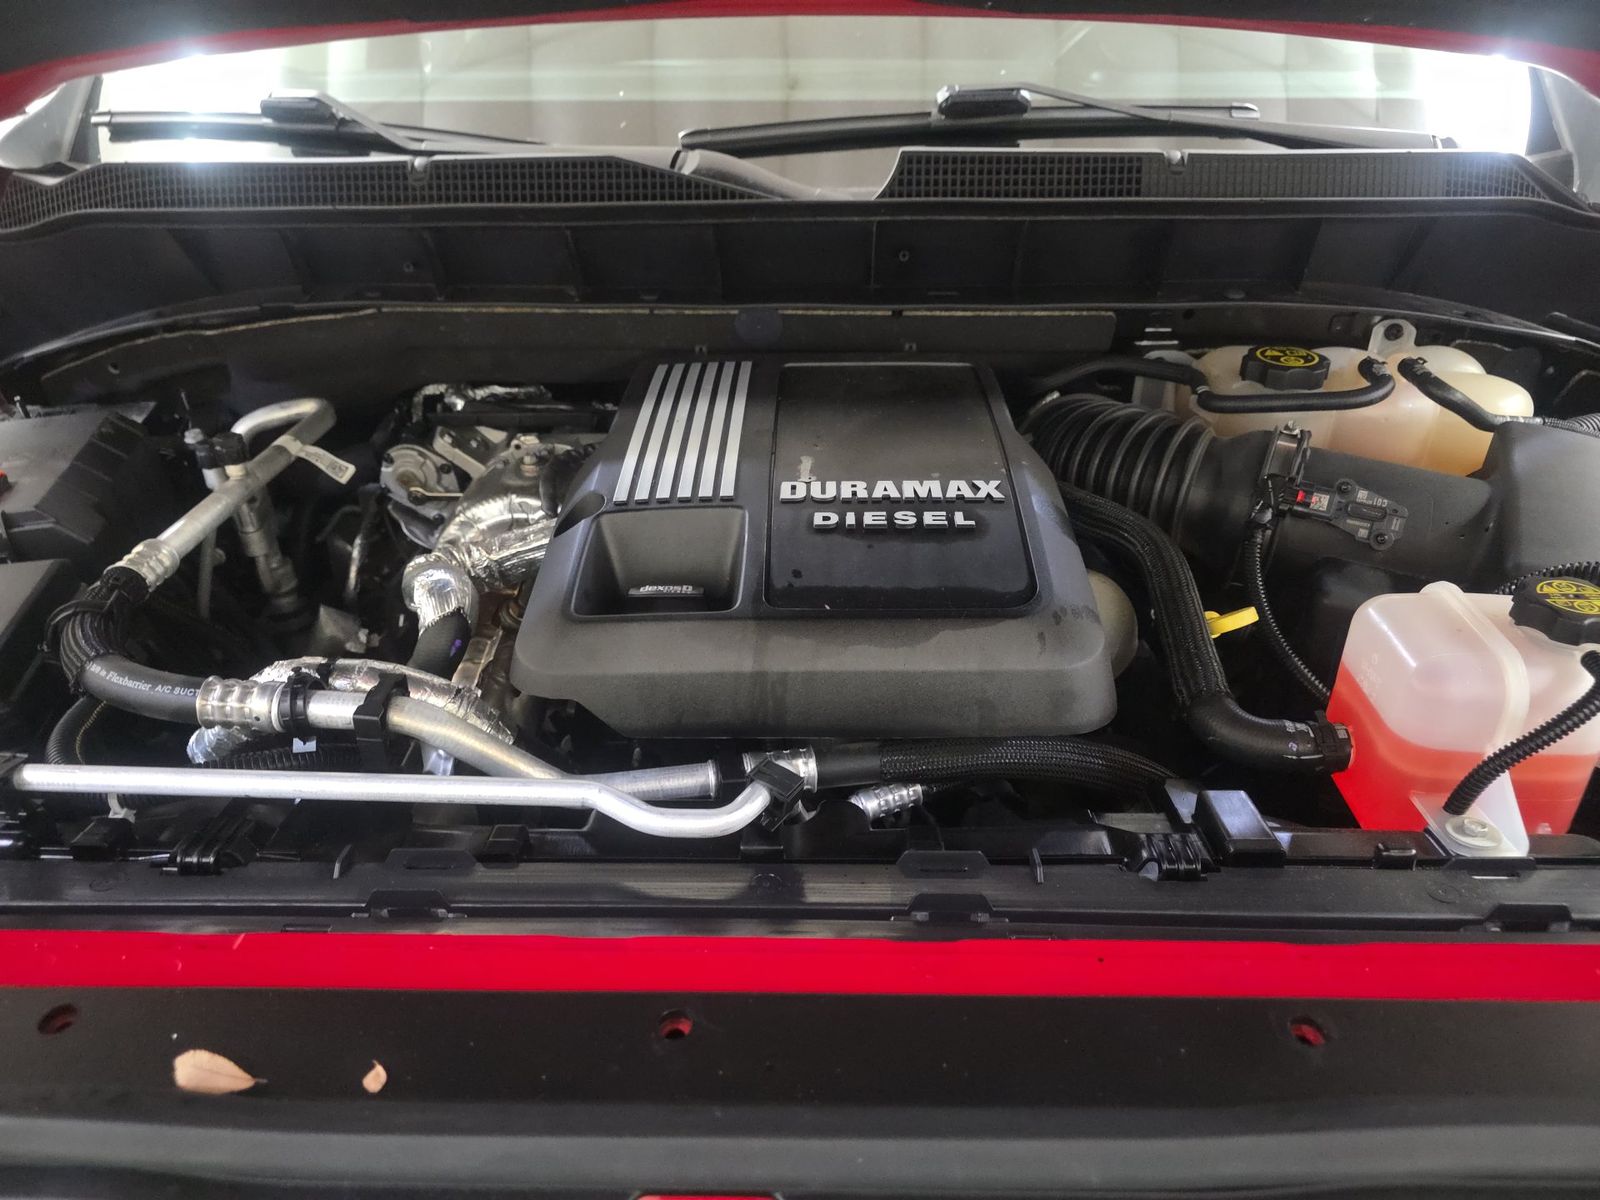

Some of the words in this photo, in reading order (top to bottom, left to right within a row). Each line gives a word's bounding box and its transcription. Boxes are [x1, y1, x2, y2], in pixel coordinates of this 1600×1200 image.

[779, 480, 1006, 502] DURAMAX
[813, 511, 976, 528] DIESEL
[106, 671, 152, 691] Flexbarrier
[155, 684, 172, 693] A/C
